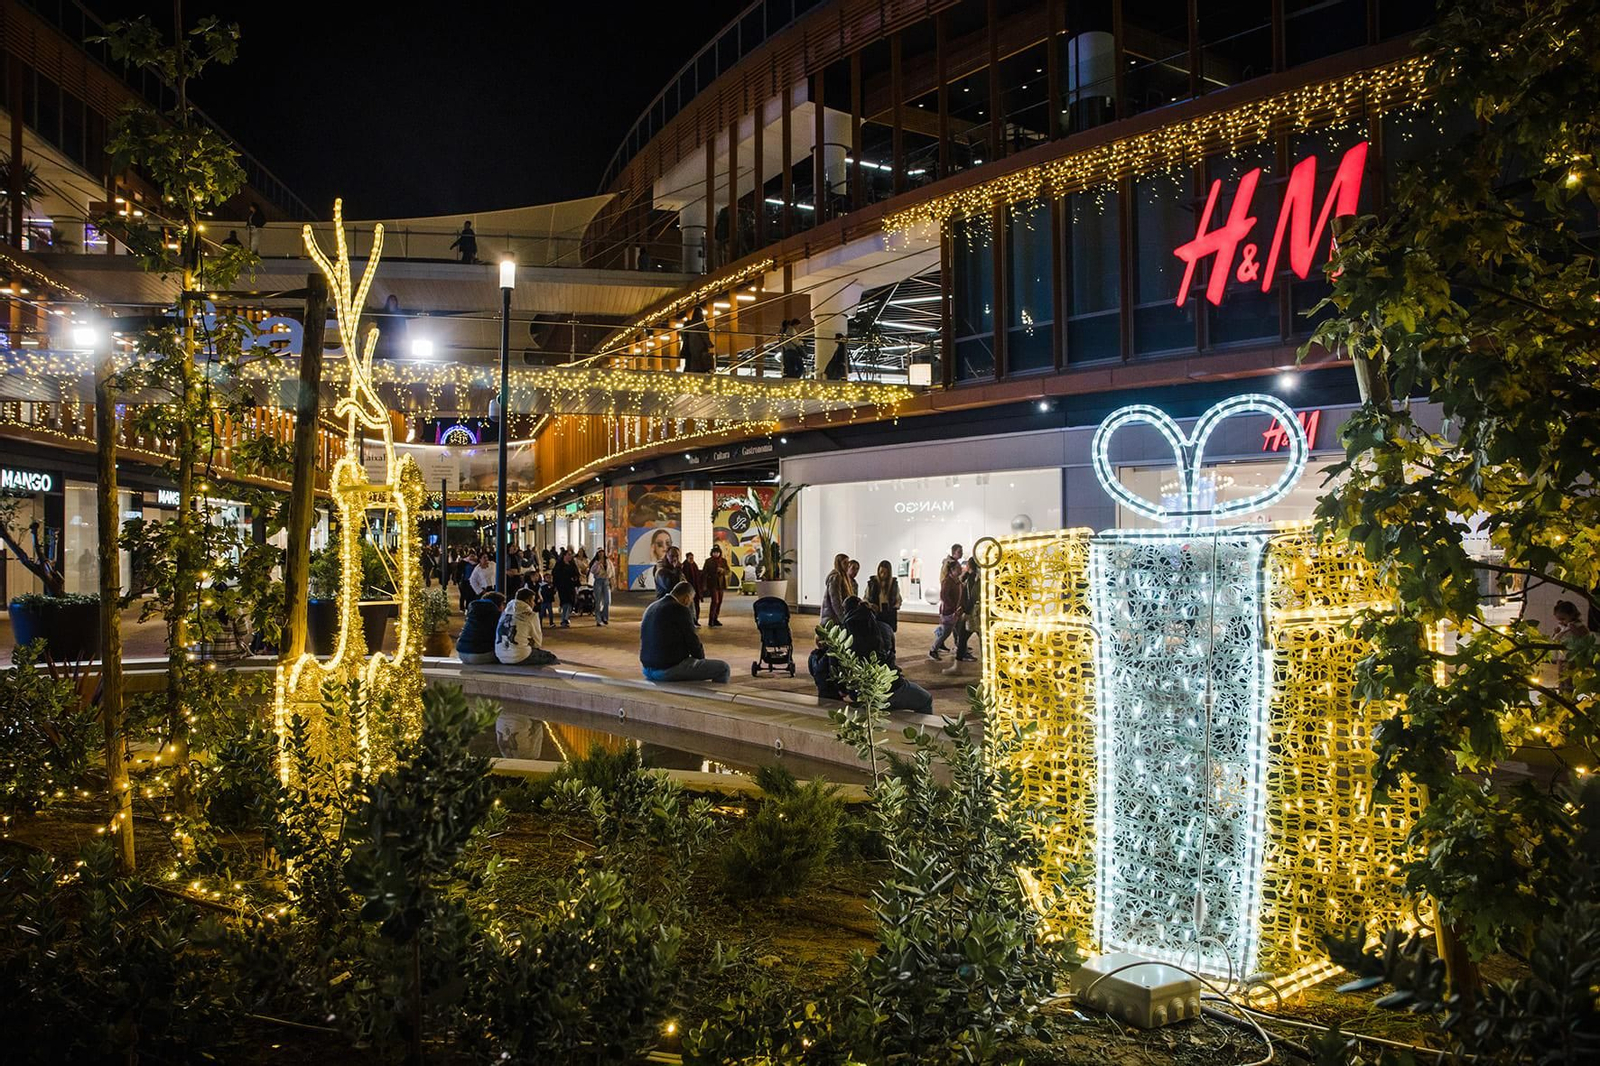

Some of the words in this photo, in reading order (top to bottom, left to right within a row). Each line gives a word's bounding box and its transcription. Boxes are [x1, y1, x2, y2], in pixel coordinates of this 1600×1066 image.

[1173, 141, 1368, 307] H&M
[1, 469, 52, 492] MANGO
[158, 489, 181, 506] MANG
